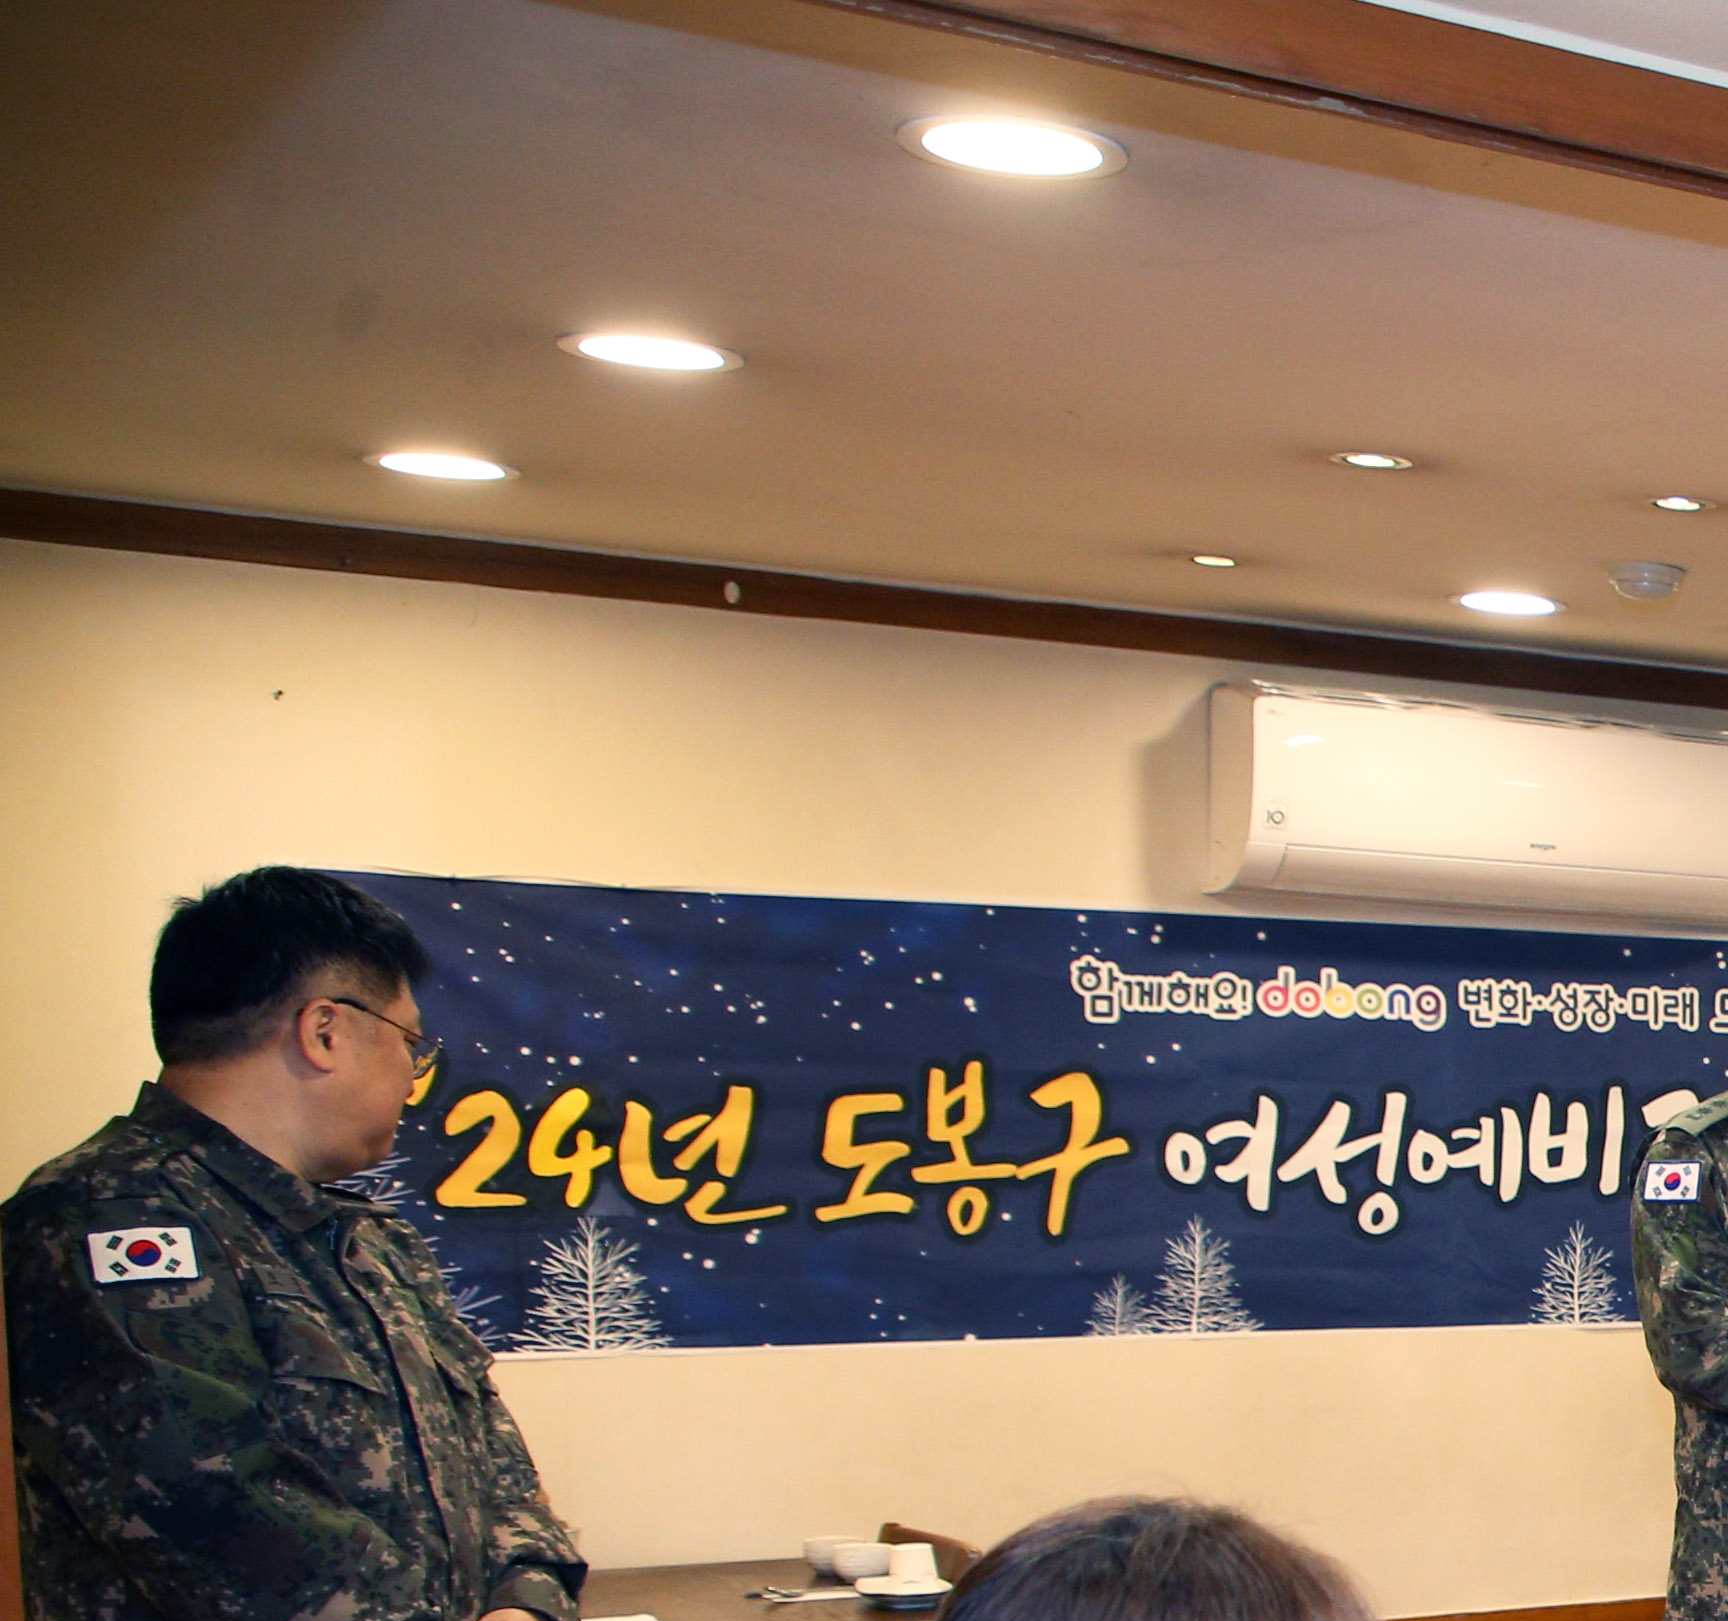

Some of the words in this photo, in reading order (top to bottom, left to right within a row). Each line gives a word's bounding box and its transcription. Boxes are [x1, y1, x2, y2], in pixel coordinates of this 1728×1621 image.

[1069, 954, 1253, 1023] 함께해요!
[1256, 965, 1447, 1032] dobong
[1458, 978, 1700, 1033] 변화·성장·미래
[814, 1060, 1130, 1236] 도봉구
[1164, 1085, 1700, 1236] 여성예비
